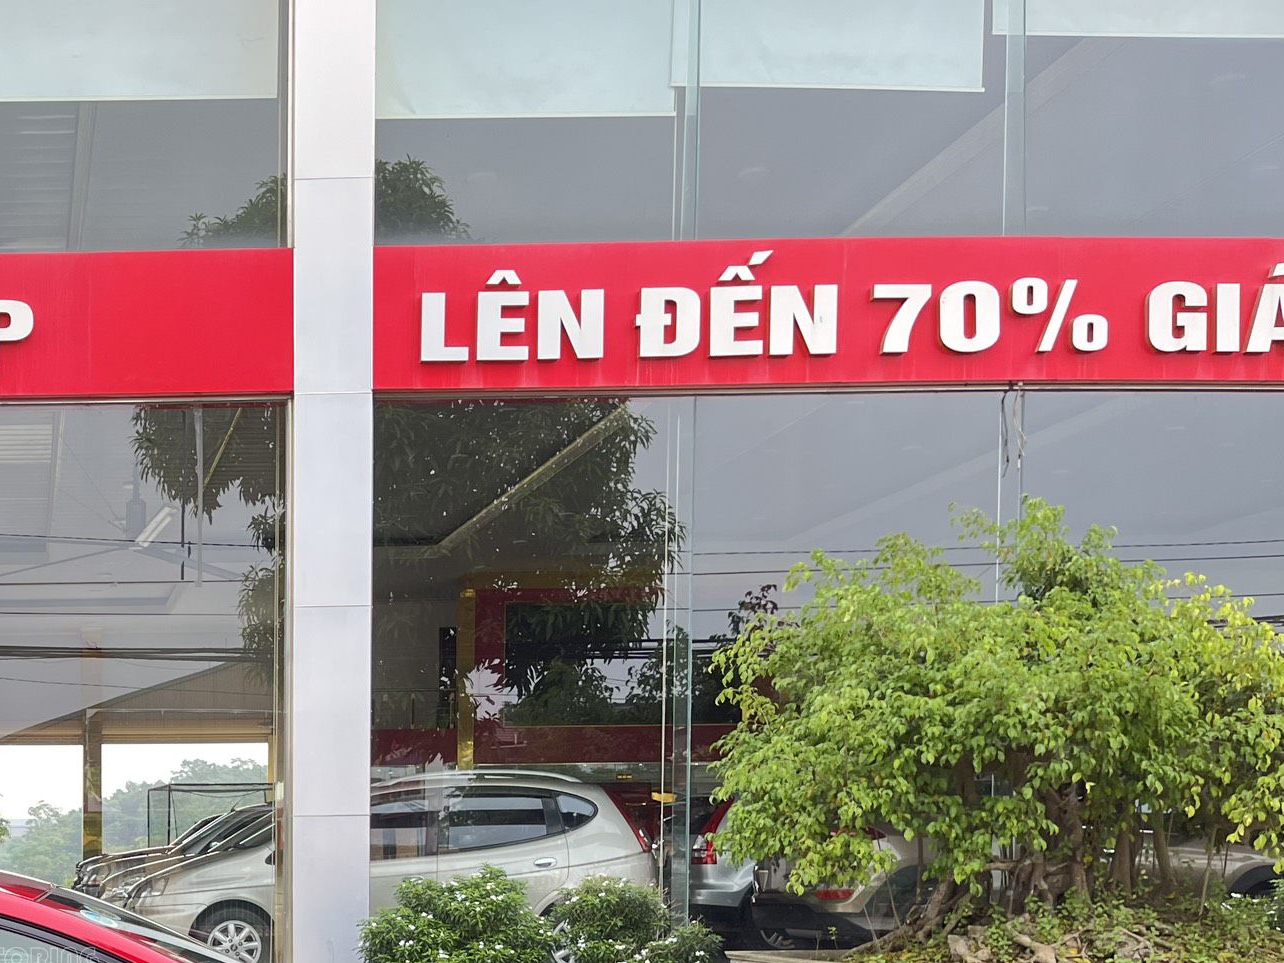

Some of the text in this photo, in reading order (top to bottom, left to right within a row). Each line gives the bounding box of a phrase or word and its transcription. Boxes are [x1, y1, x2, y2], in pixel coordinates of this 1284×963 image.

[420, 269, 605, 362] LÊN
[635, 250, 839, 358] ĐẾN
[870, 276, 1109, 356] 70%
